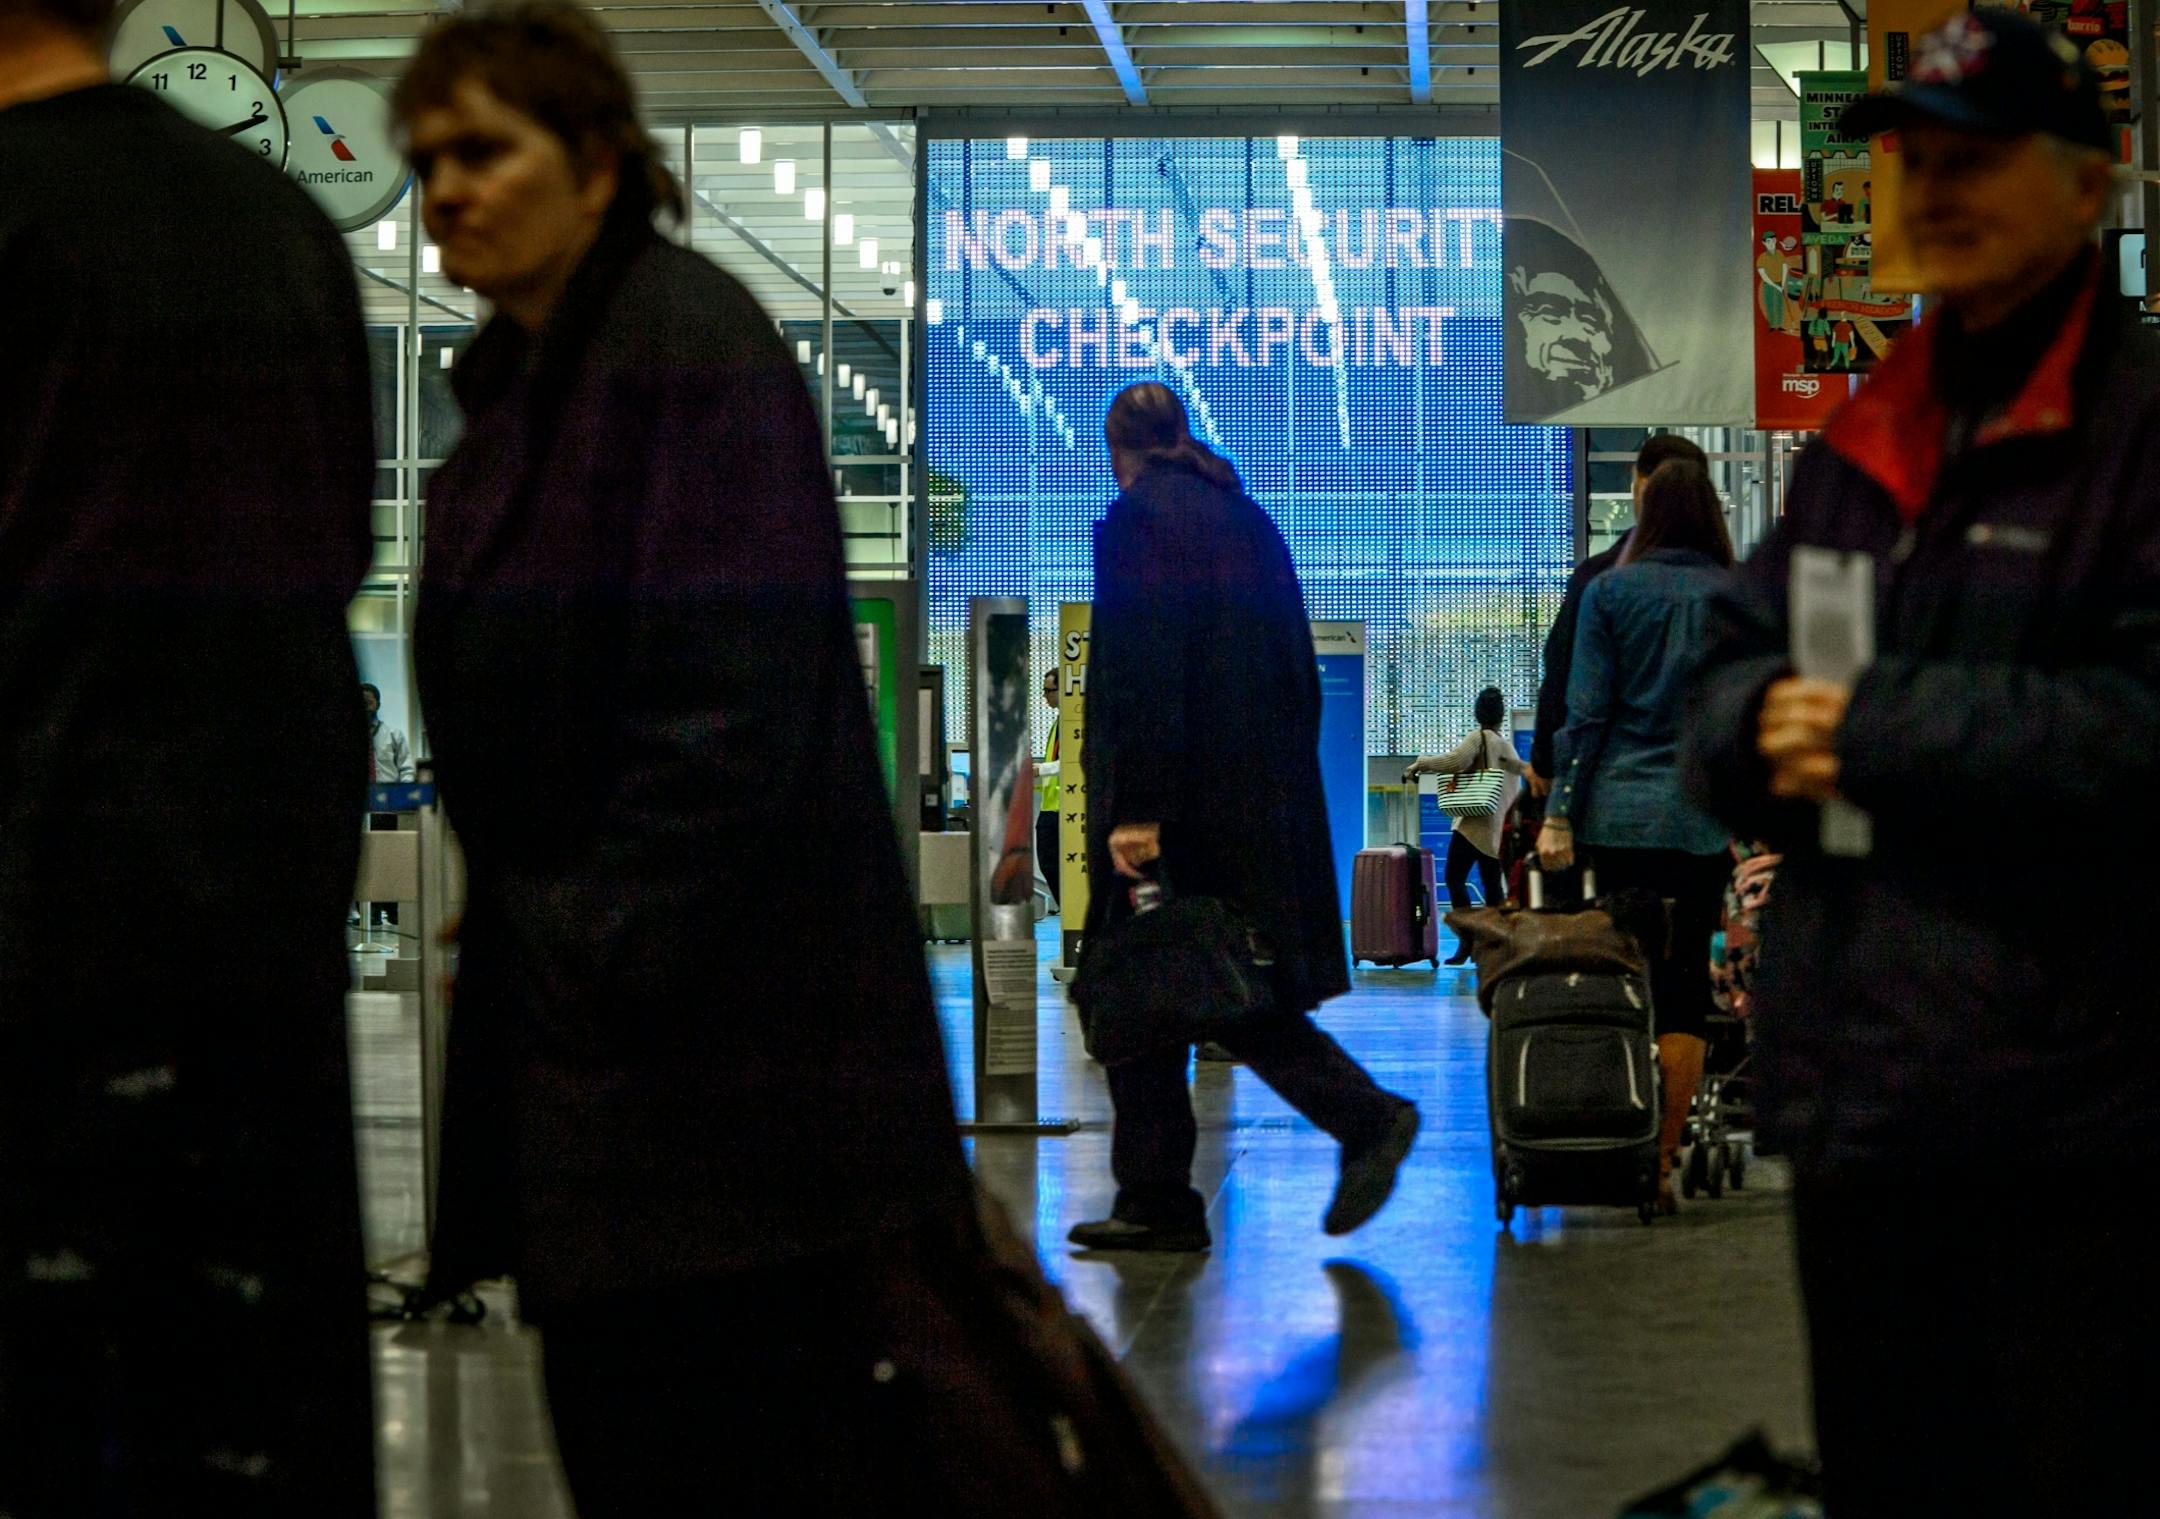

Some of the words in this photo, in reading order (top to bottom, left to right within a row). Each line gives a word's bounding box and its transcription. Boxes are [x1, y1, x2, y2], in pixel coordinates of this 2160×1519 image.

[2067, 20, 2101, 33] barrio
[1515, 5, 1736, 78] Alaska
[186, 63, 207, 80] 12
[151, 73, 169, 90] 11
[228, 74, 237, 91] 1
[251, 101, 264, 118] 2
[258, 138, 272, 156] 3
[296, 168, 373, 185] American
[1760, 195, 1803, 213] REL
[945, 207, 1175, 270] NORTH
[1199, 207, 1503, 269] SECURIT
[1803, 234, 1846, 244] AVEDA
[1020, 306, 1455, 368] CHECKPOINT
[1781, 379, 1820, 395] msp
